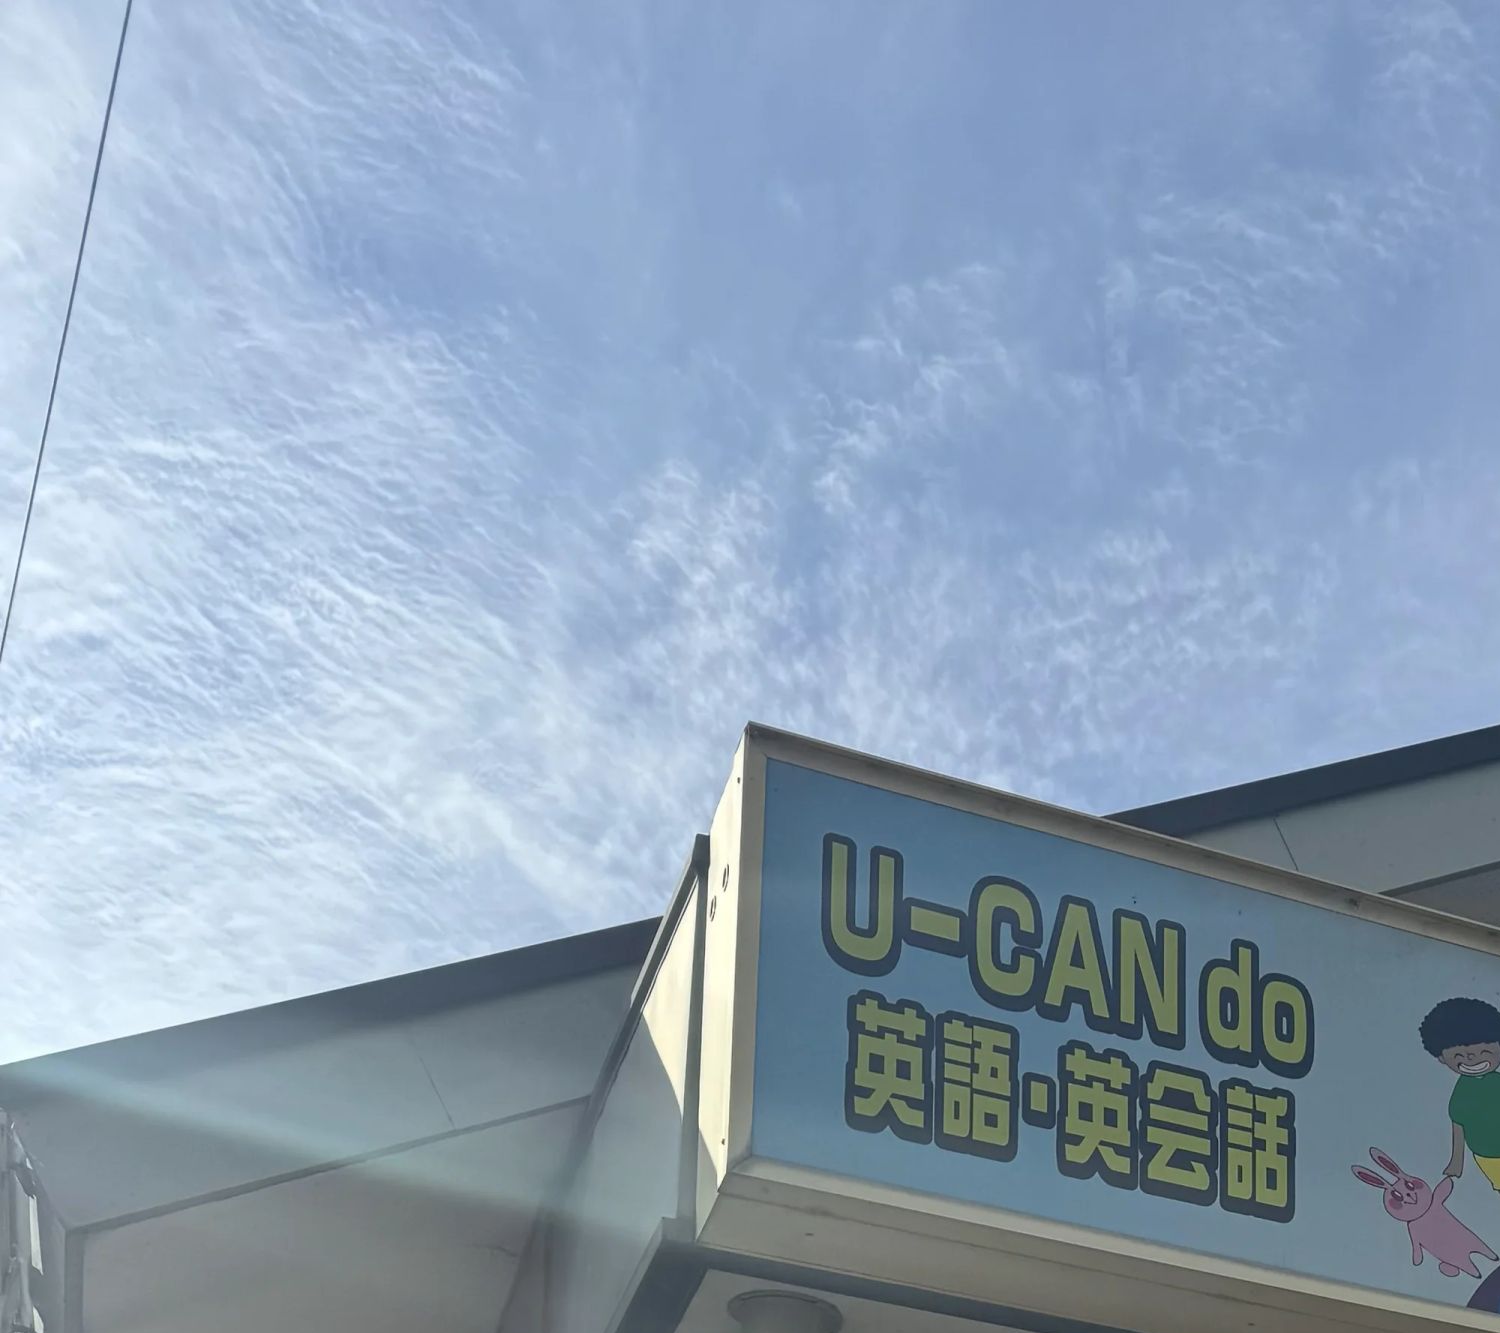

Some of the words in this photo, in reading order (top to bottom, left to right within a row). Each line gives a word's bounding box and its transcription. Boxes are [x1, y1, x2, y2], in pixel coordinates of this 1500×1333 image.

[845, 990, 1296, 1223] 英語・英会話
